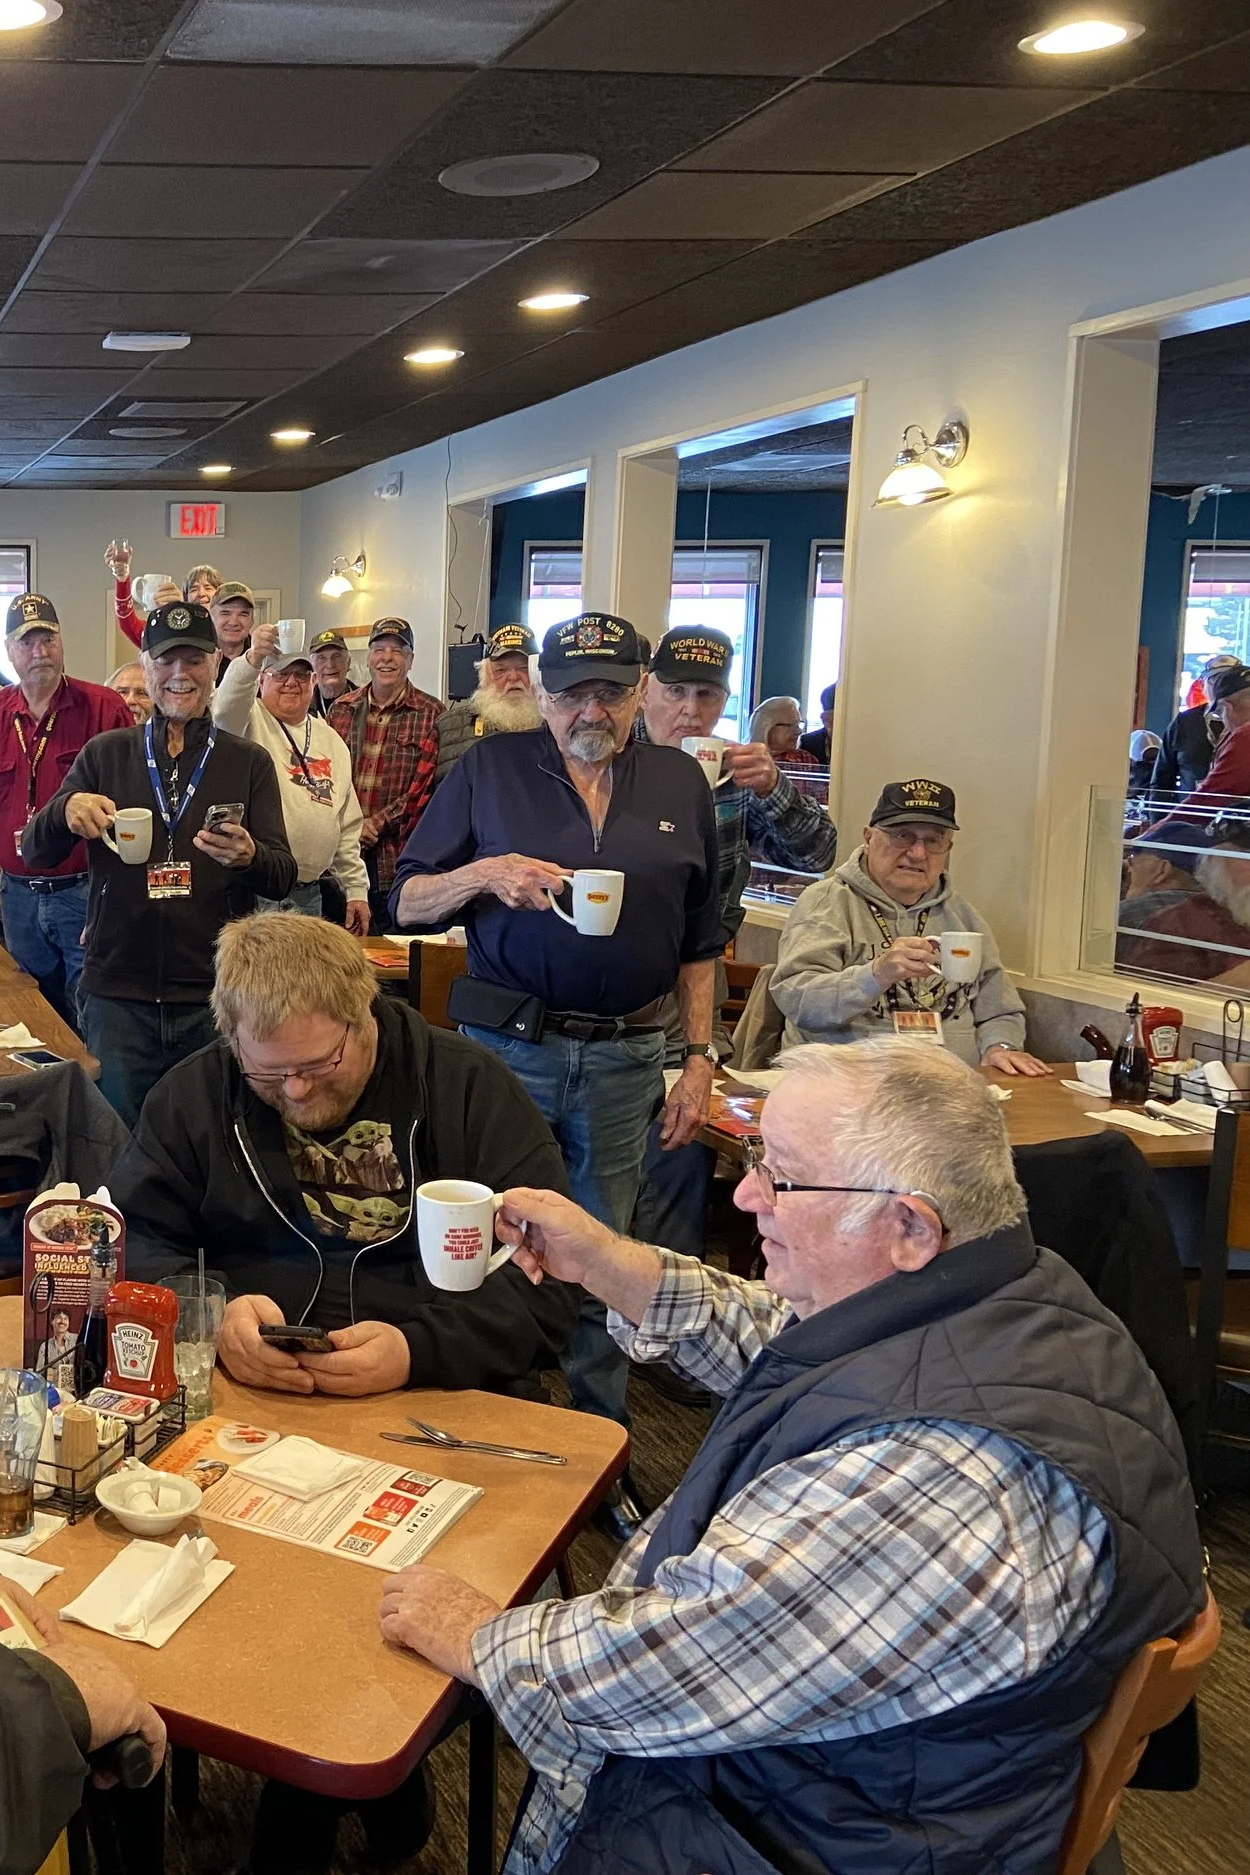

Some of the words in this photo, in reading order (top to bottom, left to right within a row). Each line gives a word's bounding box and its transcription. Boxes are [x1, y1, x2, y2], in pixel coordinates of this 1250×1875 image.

[181, 504, 217, 535] EXIT
[25, 595, 47, 605] ARMY
[556, 622, 575, 638] VFW
[577, 617, 602, 626] POST
[606, 620, 625, 637] 8280
[670, 638, 706, 650] WORLD
[706, 639, 725, 656] WAR
[675, 653, 724, 667] VETERAN
[902, 780, 942, 795] WWII
[904, 800, 940, 808] VETERAN
[35, 1253, 75, 1263] SOCIAL
[77, 1255, 91, 1264] ST
[34, 1262, 88, 1272] INFLUENCED
[122, 1330, 144, 1340] HEINZ
[121, 1341, 146, 1351] TOMATO
[166, 1433, 216, 1474] esserts
[237, 1495, 265, 1520] meals
